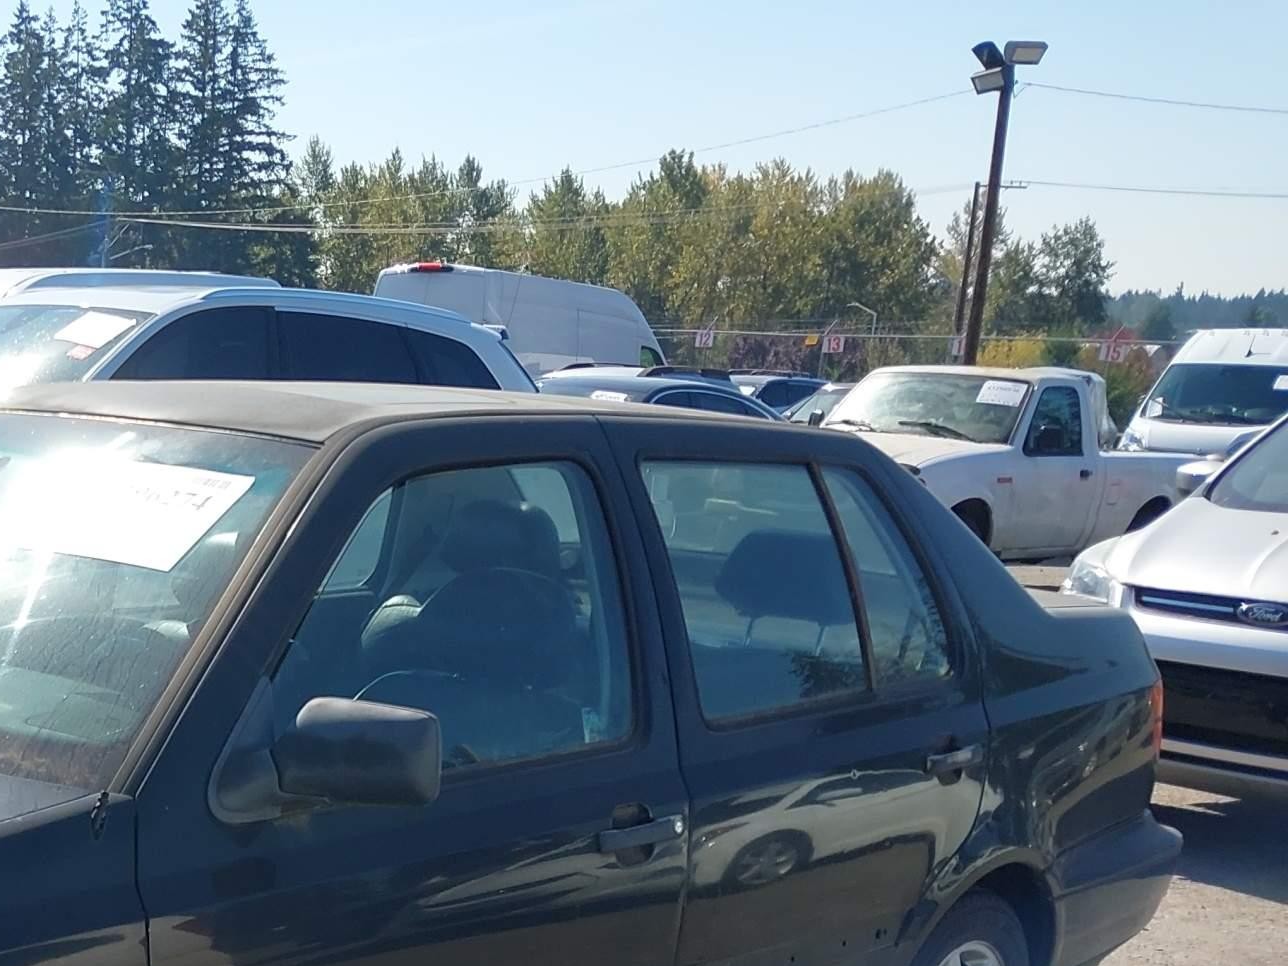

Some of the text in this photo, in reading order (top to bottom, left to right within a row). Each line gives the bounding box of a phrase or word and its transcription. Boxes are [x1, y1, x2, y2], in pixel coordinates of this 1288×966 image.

[698, 334, 711, 346] 12
[827, 336, 841, 351] 13
[1105, 344, 1121, 360] 15
